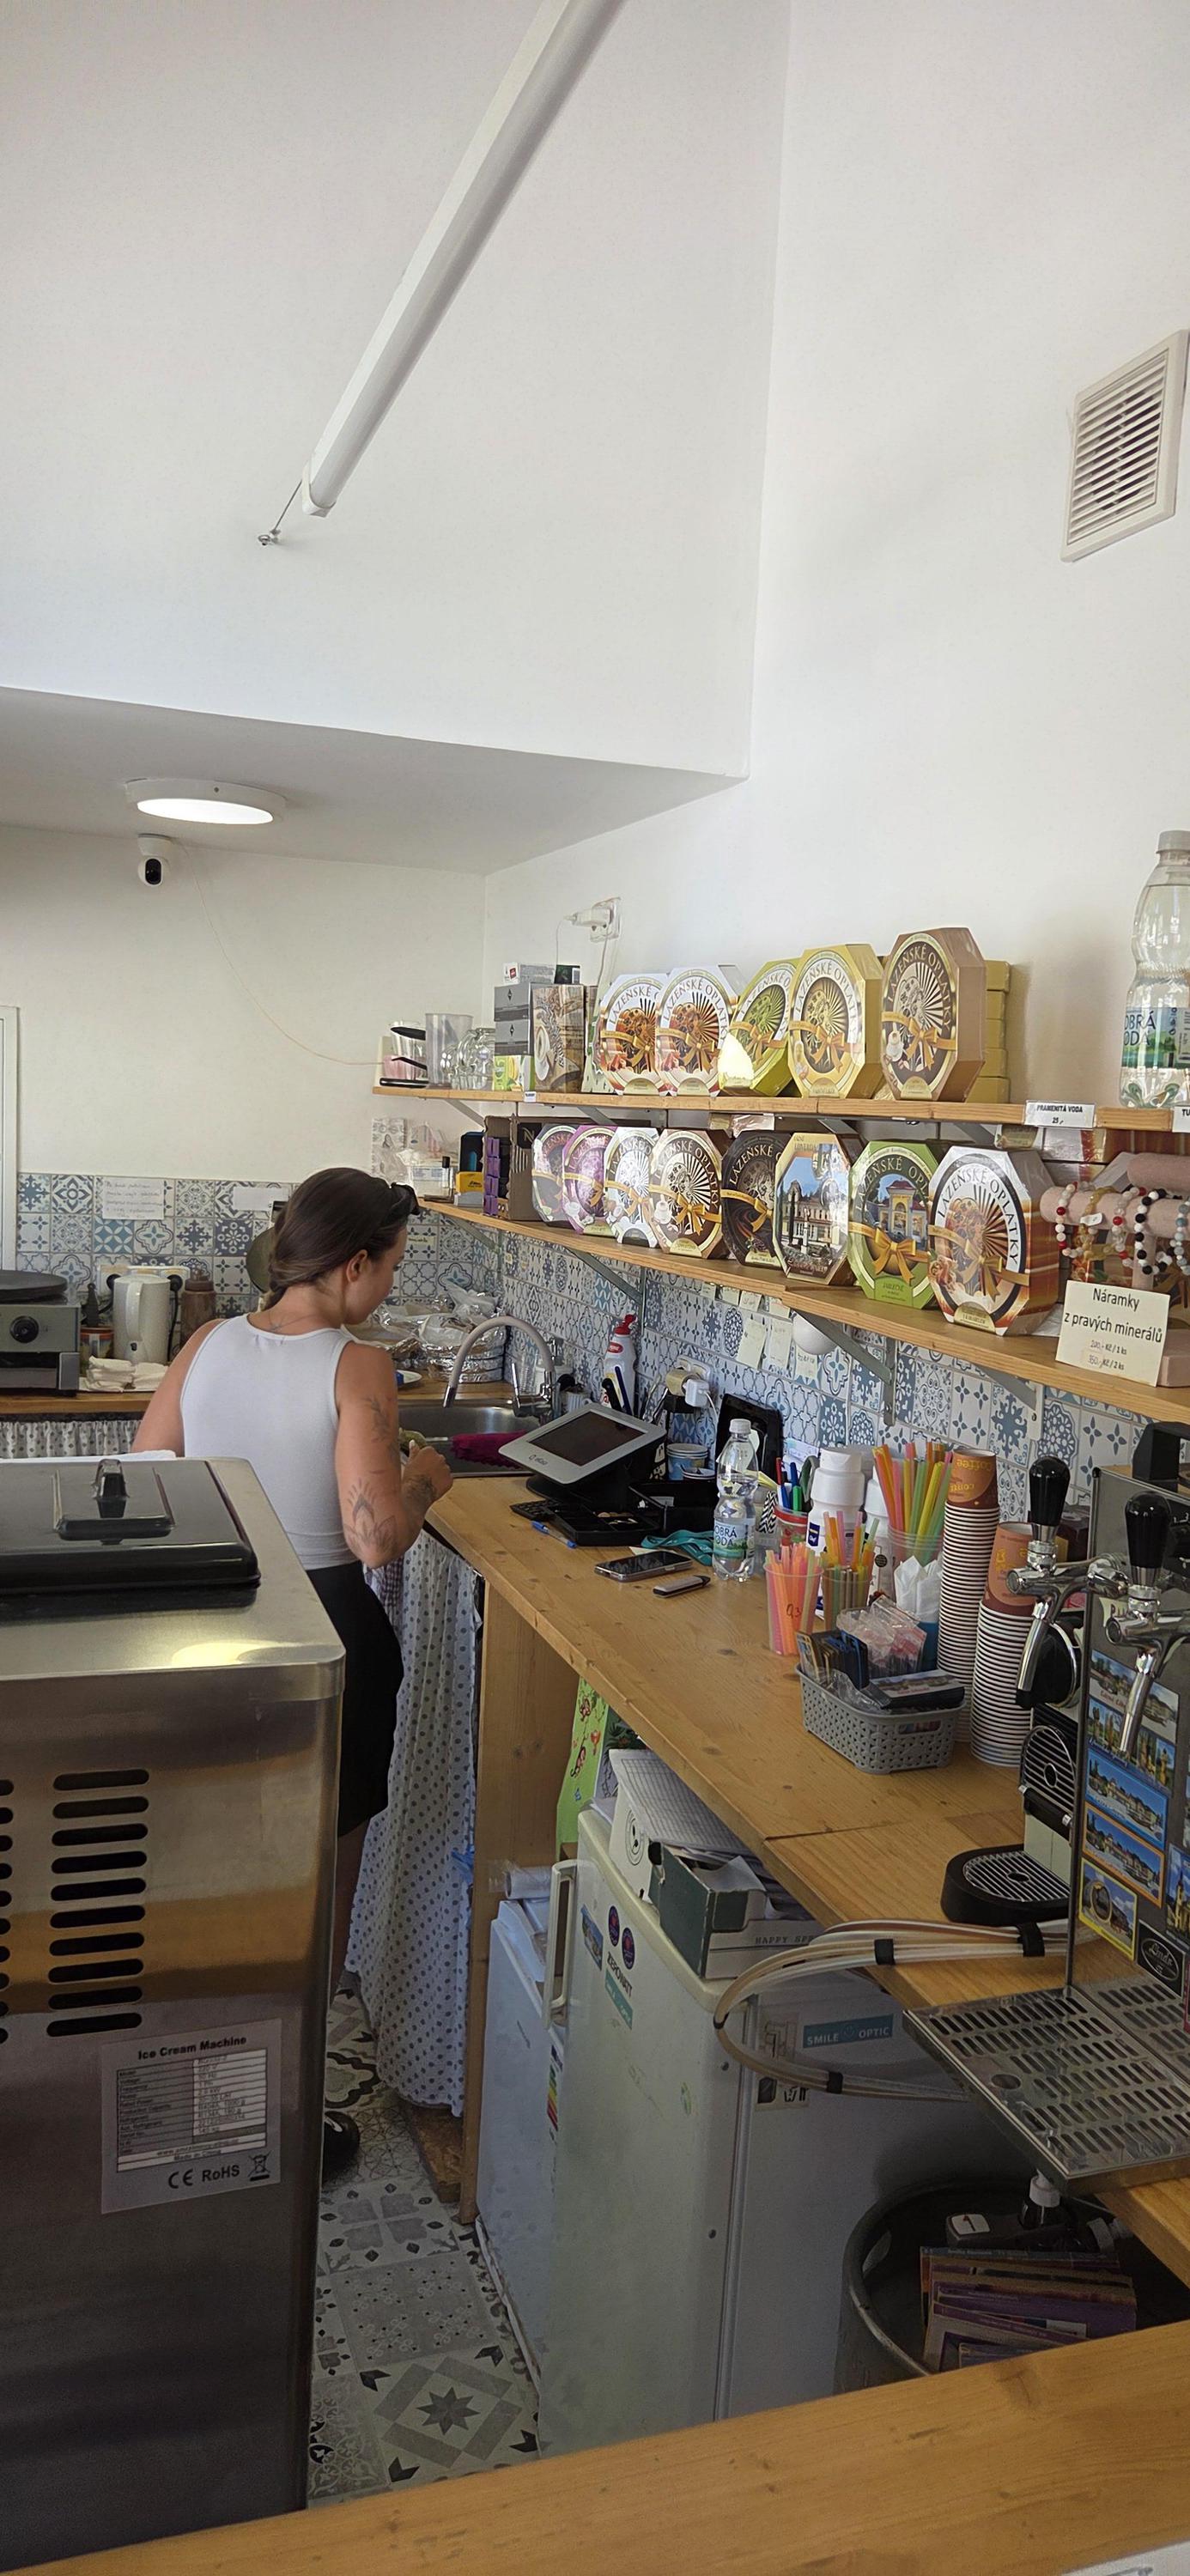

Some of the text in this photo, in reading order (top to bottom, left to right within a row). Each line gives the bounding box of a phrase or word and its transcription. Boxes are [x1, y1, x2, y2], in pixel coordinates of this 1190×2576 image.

[730, 1144, 774, 1185] LÁZEŇSKÉ
[937, 1168, 1019, 1266] LÁZEŇSKÉ OPLATKY
[1093, 1288, 1139, 1312] Náramky
[1064, 1312, 1163, 1343] z pravých minerálů
[606, 1951, 633, 1998] ZEROWATT
[138, 2036, 247, 2060] Ice Cream Machine
[807, 2026, 889, 2045] SMILE OPTIC
[202, 2165, 240, 2183] RoHS
